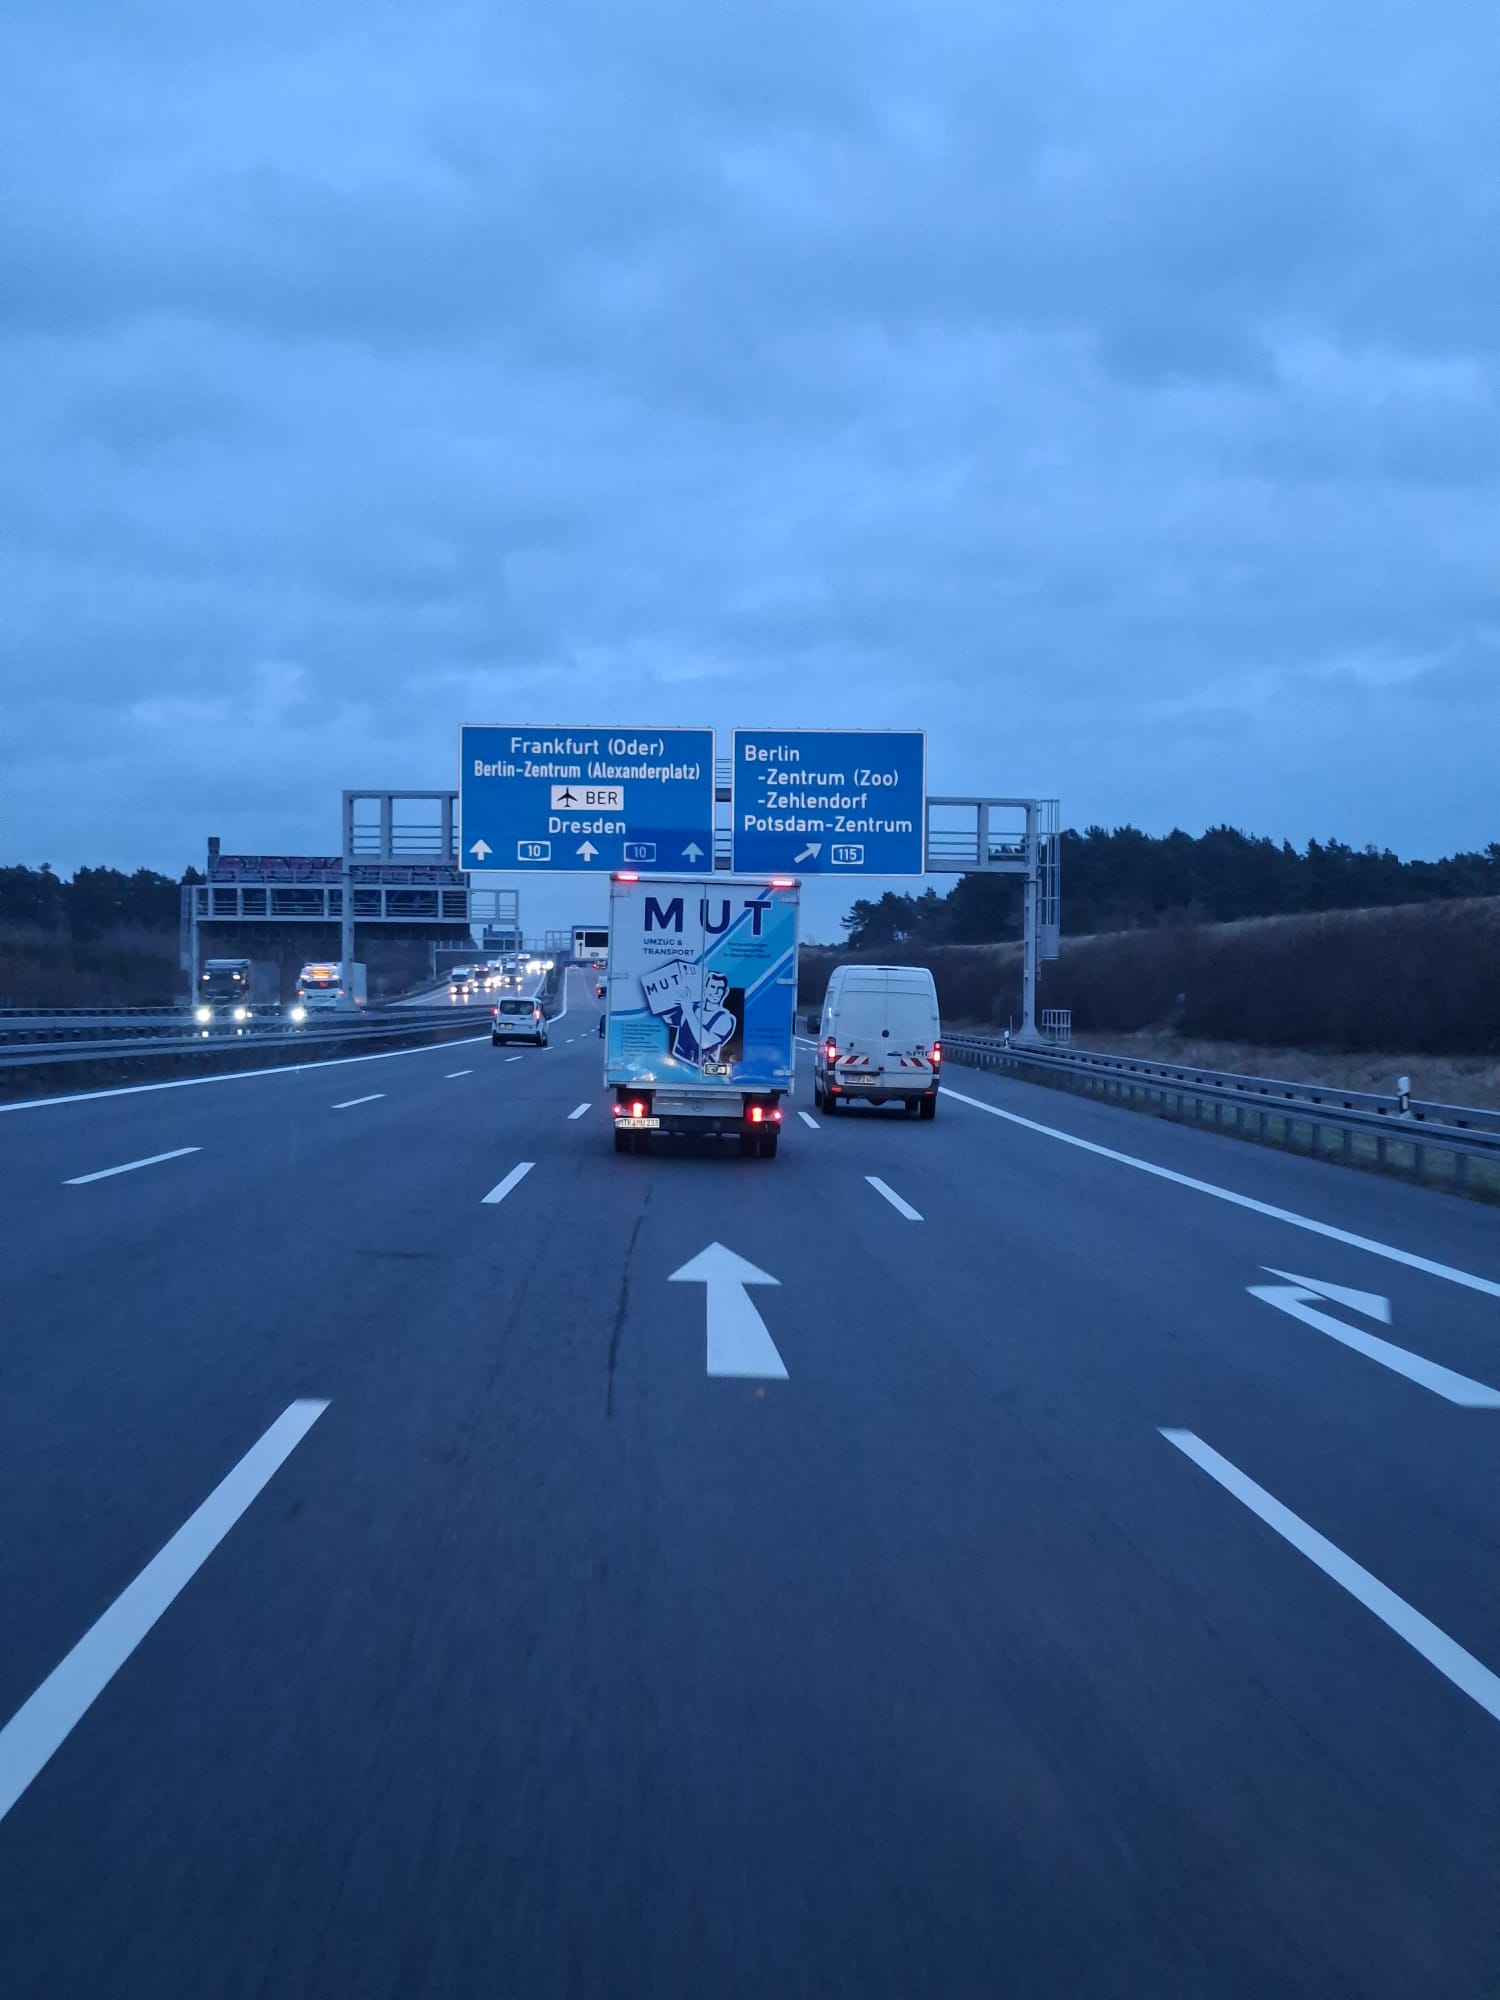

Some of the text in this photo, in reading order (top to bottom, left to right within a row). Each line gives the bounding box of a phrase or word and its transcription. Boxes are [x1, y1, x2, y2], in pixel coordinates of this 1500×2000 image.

[510, 737, 665, 757] Frankfurt (Oder)
[744, 744, 800, 762] Berlin
[474, 760, 700, 783] Berlin-Zentrum (Alexanderplatz)
[757, 768, 899, 787] -Zentrum (Zoo)
[586, 791, 618, 805] BER
[757, 791, 868, 809] -Zehlendorf
[548, 817, 626, 834] Dresden
[744, 814, 912, 833] Potsdam-Zentrum
[527, 844, 541, 857] 10
[633, 846, 647, 858] 10
[838, 848, 857, 861] 115
[644, 896, 772, 936] MUT
[643, 938, 683, 946] UMZUG &
[643, 947, 695, 956] TRANSPORT
[646, 974, 681, 996] MUT
